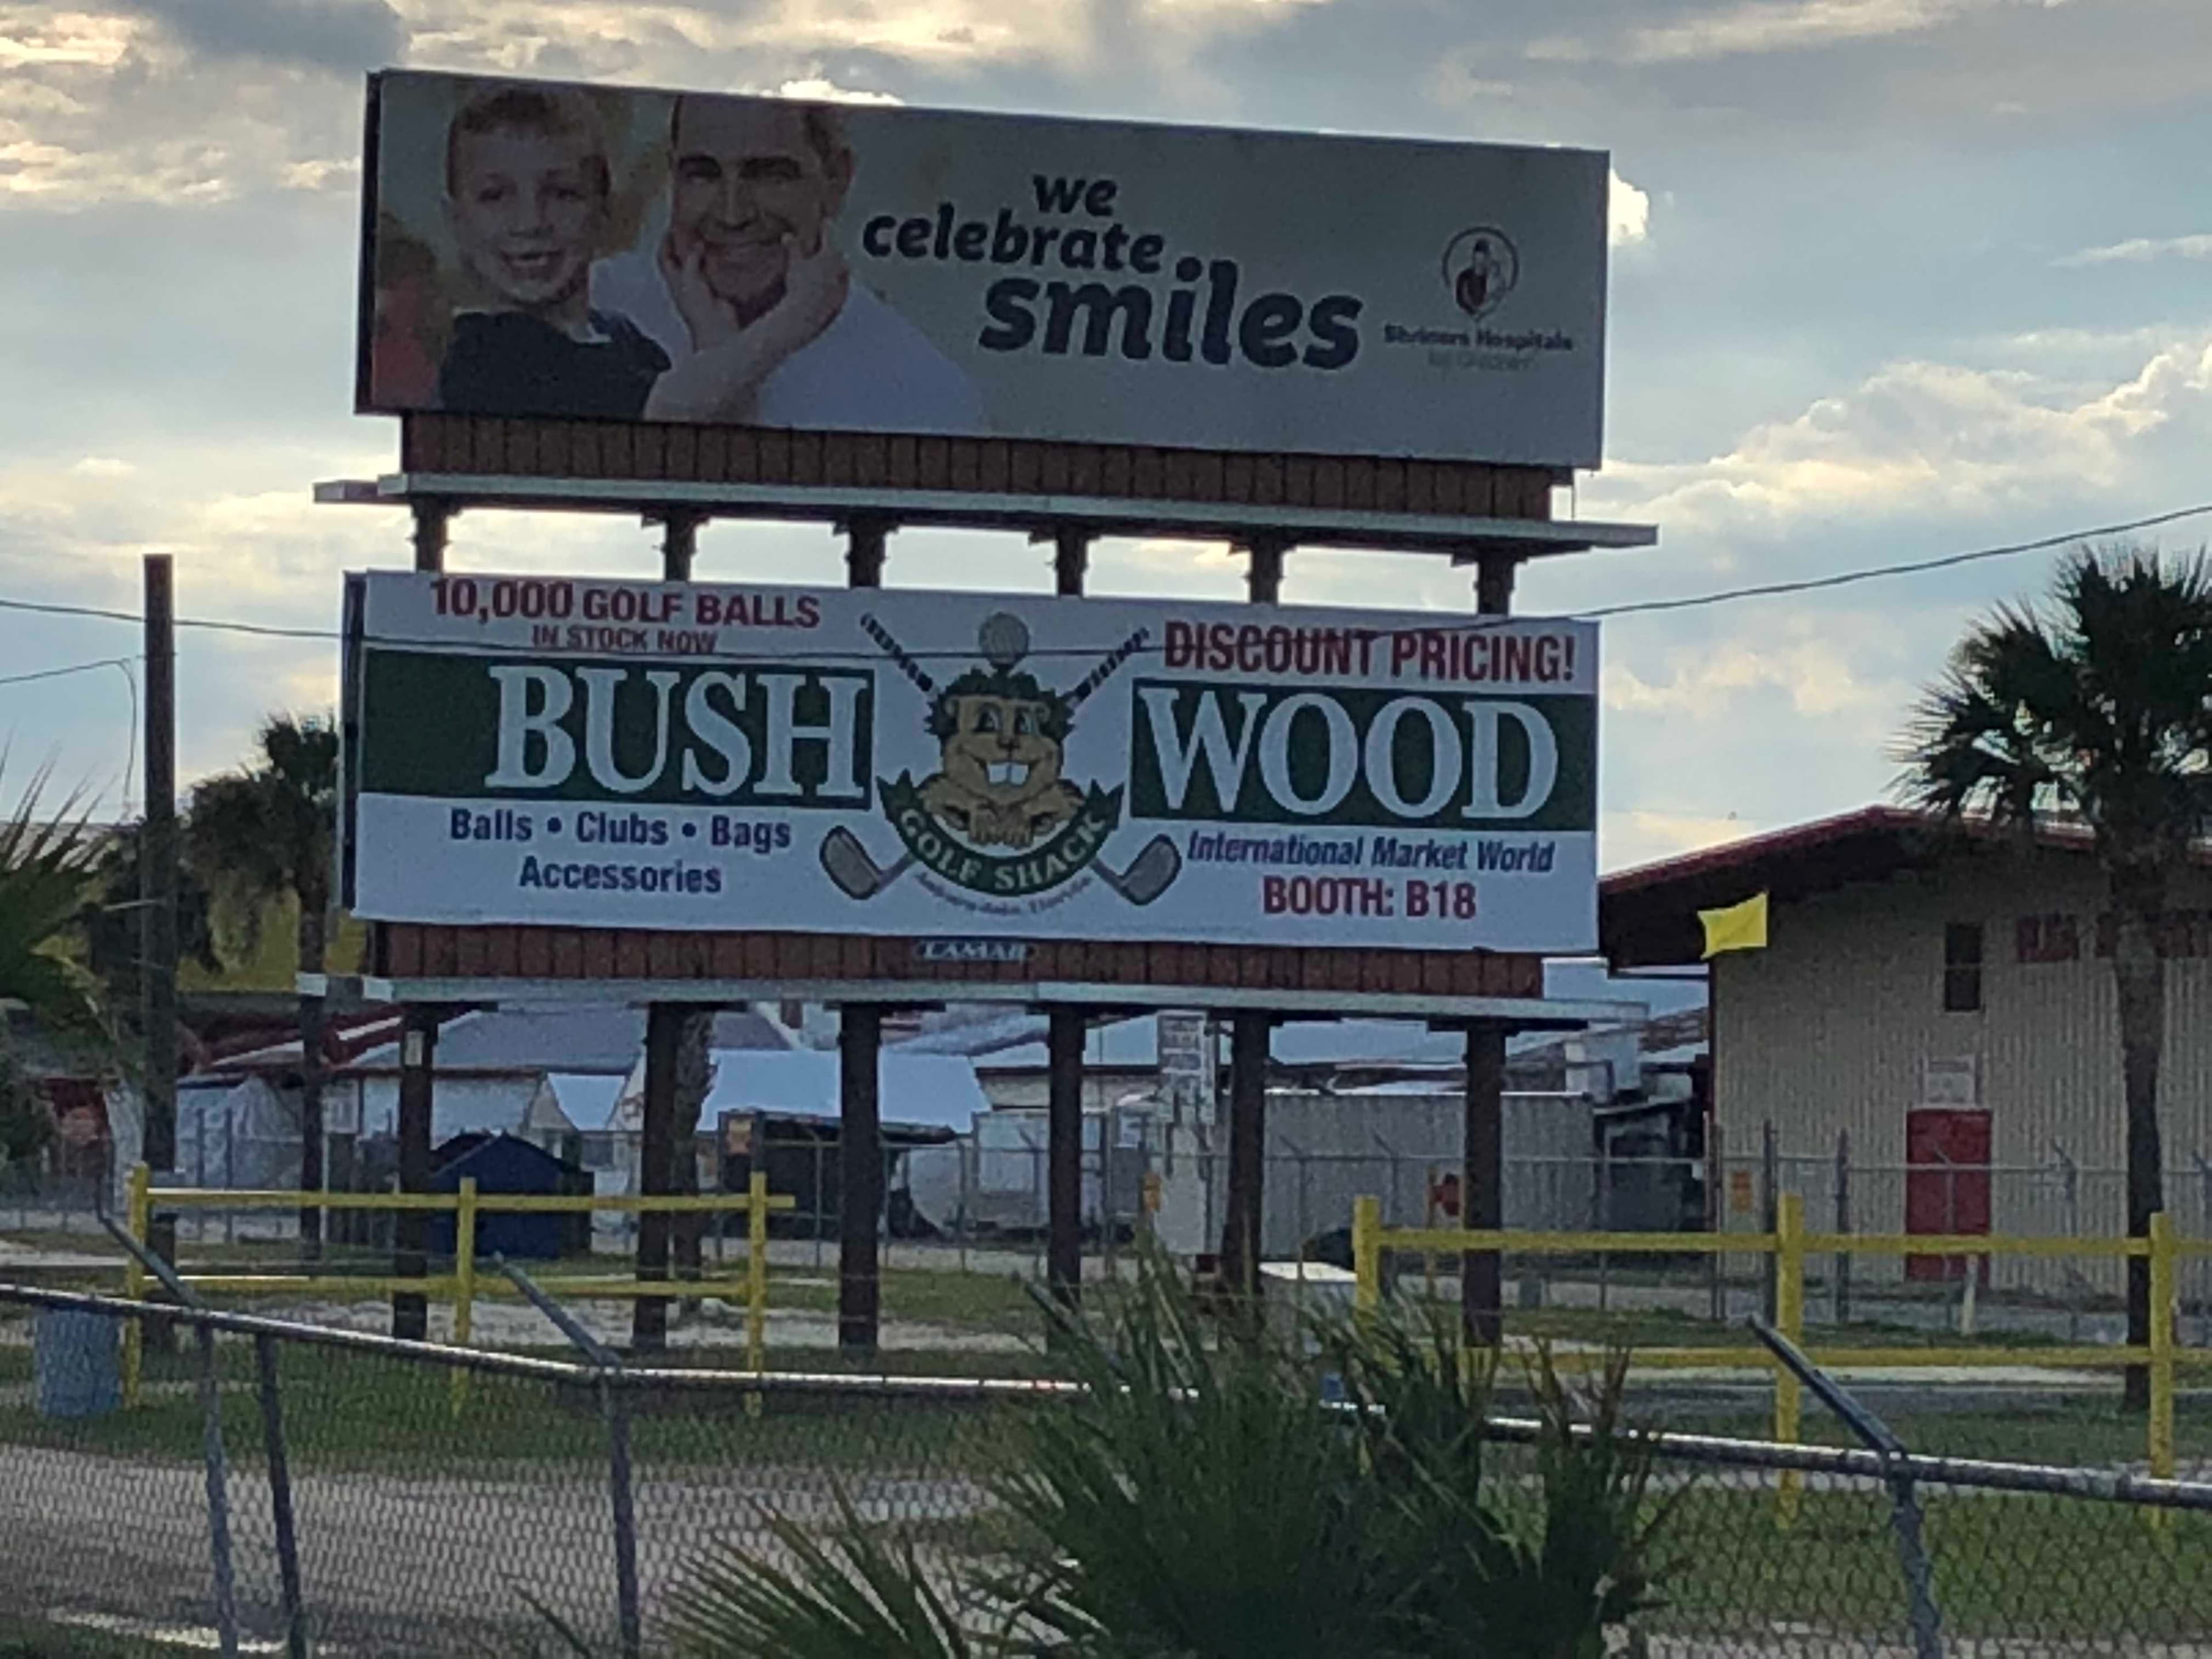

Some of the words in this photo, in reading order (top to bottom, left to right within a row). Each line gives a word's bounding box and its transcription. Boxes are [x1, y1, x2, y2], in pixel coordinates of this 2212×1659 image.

[1033, 173, 1117, 217] we
[862, 204, 1164, 274] celebrate
[979, 256, 1363, 369] smiles
[430, 578, 573, 623] 10,000
[583, 586, 683, 622] GOLF
[696, 593, 820, 629] BALLS
[533, 625, 559, 647] IN
[567, 625, 647, 652] STOCK
[657, 630, 718, 654] NOW
[1164, 620, 1377, 676] DISCOUNT
[1392, 632, 1575, 682] PRICING!
[484, 665, 869, 797] BUSH
[1138, 689, 1559, 819] WOOD
[450, 809, 532, 840] Balls
[577, 812, 669, 846] Clubs
[711, 815, 791, 854] Bags
[902, 808, 981, 882] GOLF
[995, 809, 1107, 891] SHACK
[1187, 830, 1363, 867] International
[1372, 836, 1468, 870] Market
[1477, 839, 1555, 873] World
[520, 856, 721, 893] Accessories
[1263, 876, 1394, 916] BOOTH:
[1407, 881, 1476, 919] B18
